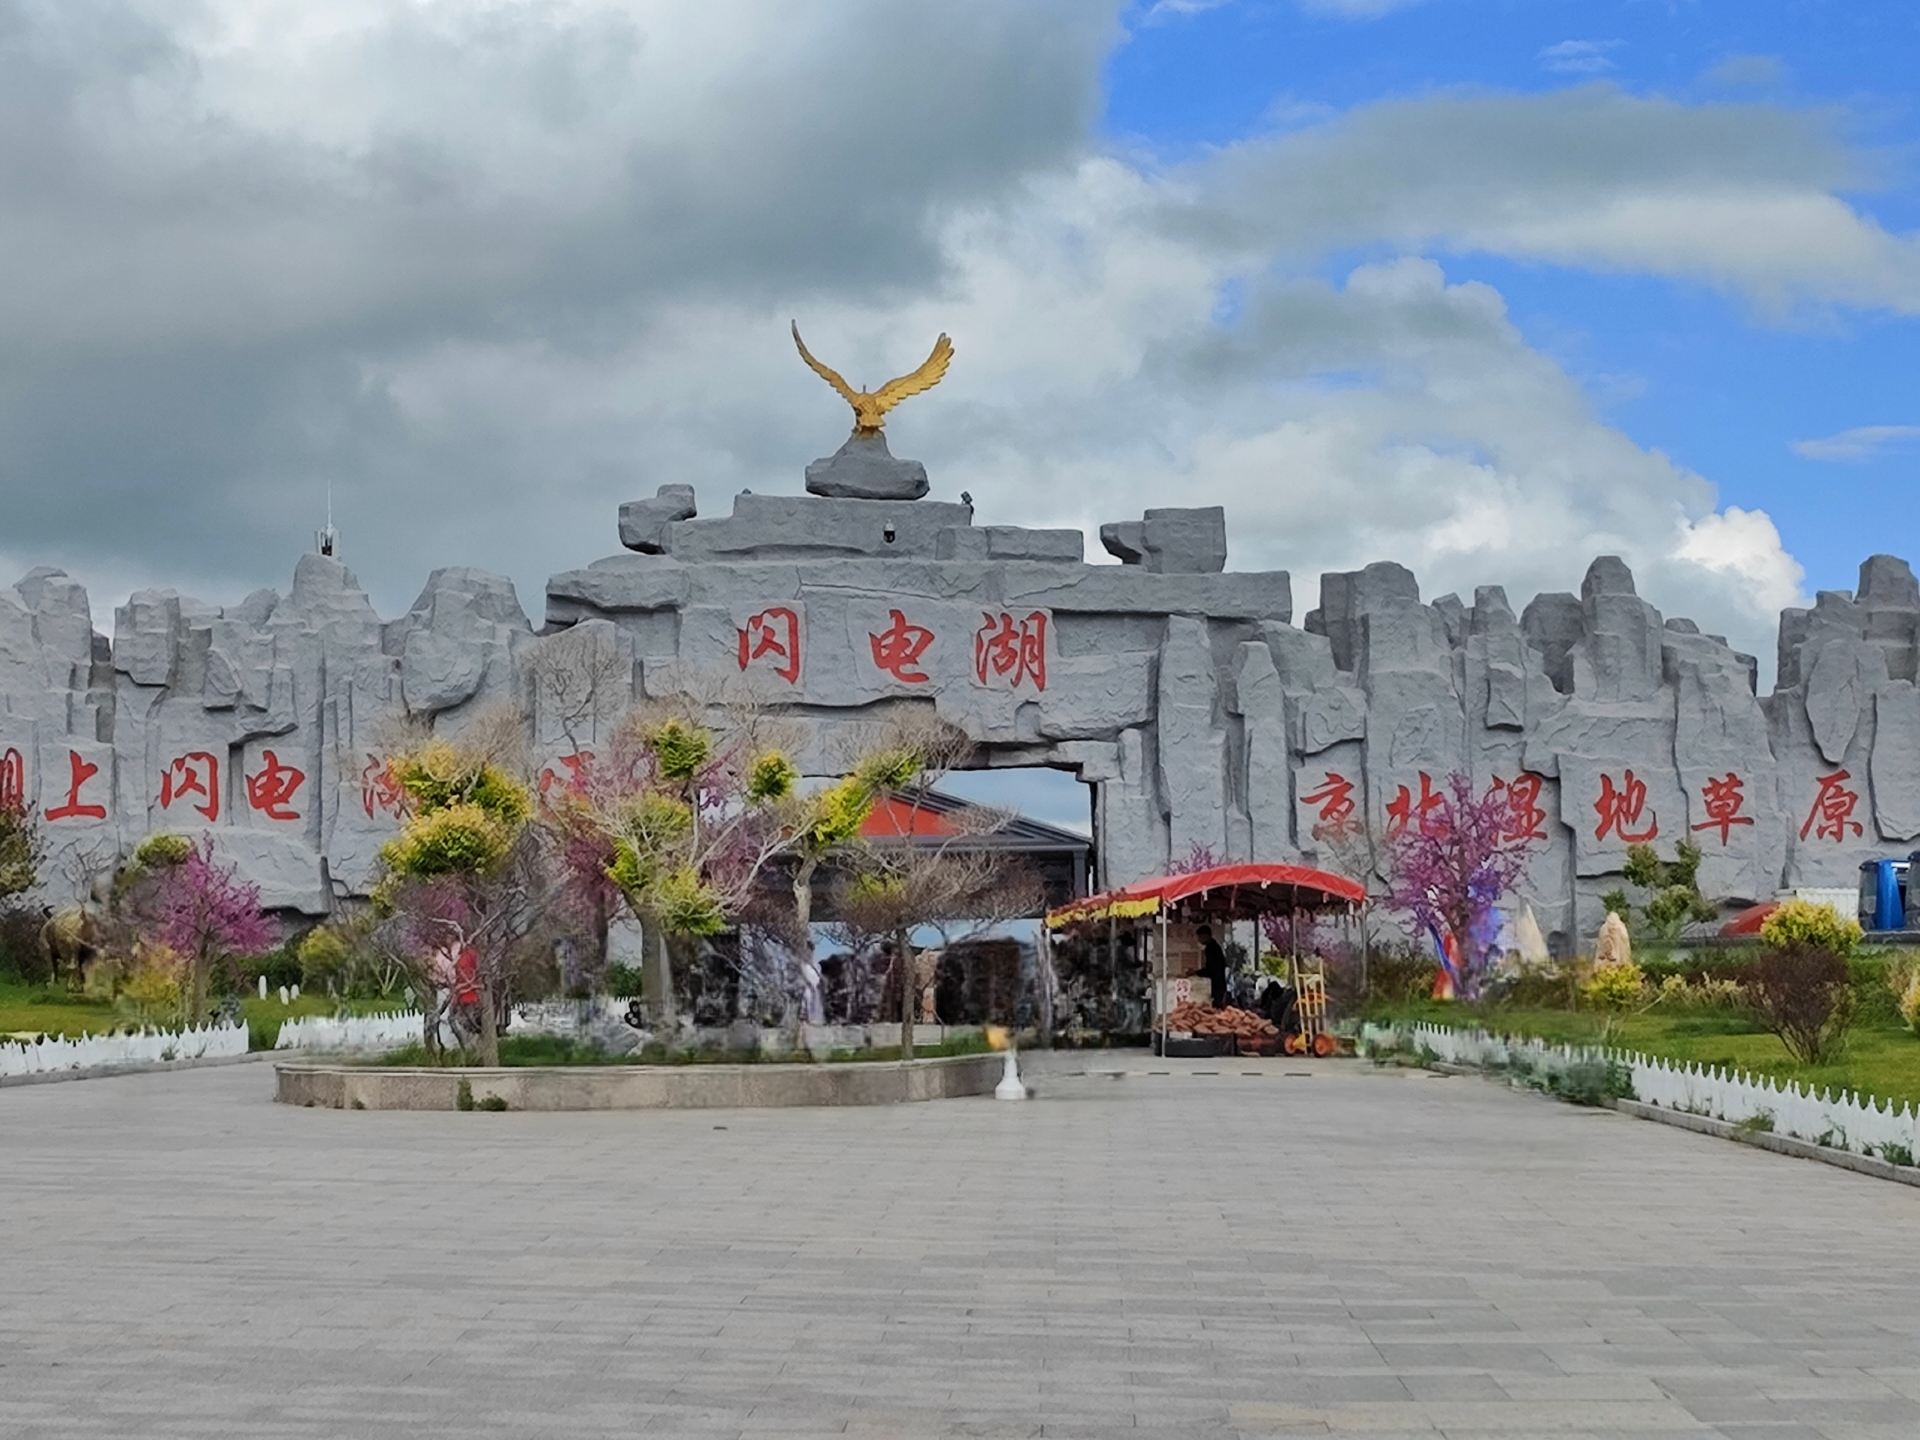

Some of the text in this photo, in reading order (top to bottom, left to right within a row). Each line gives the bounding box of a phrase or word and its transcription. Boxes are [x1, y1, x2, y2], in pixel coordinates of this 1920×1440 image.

[738, 607, 1048, 692] 闪电湖
[1300, 769, 1863, 846] 京北湿地草原
